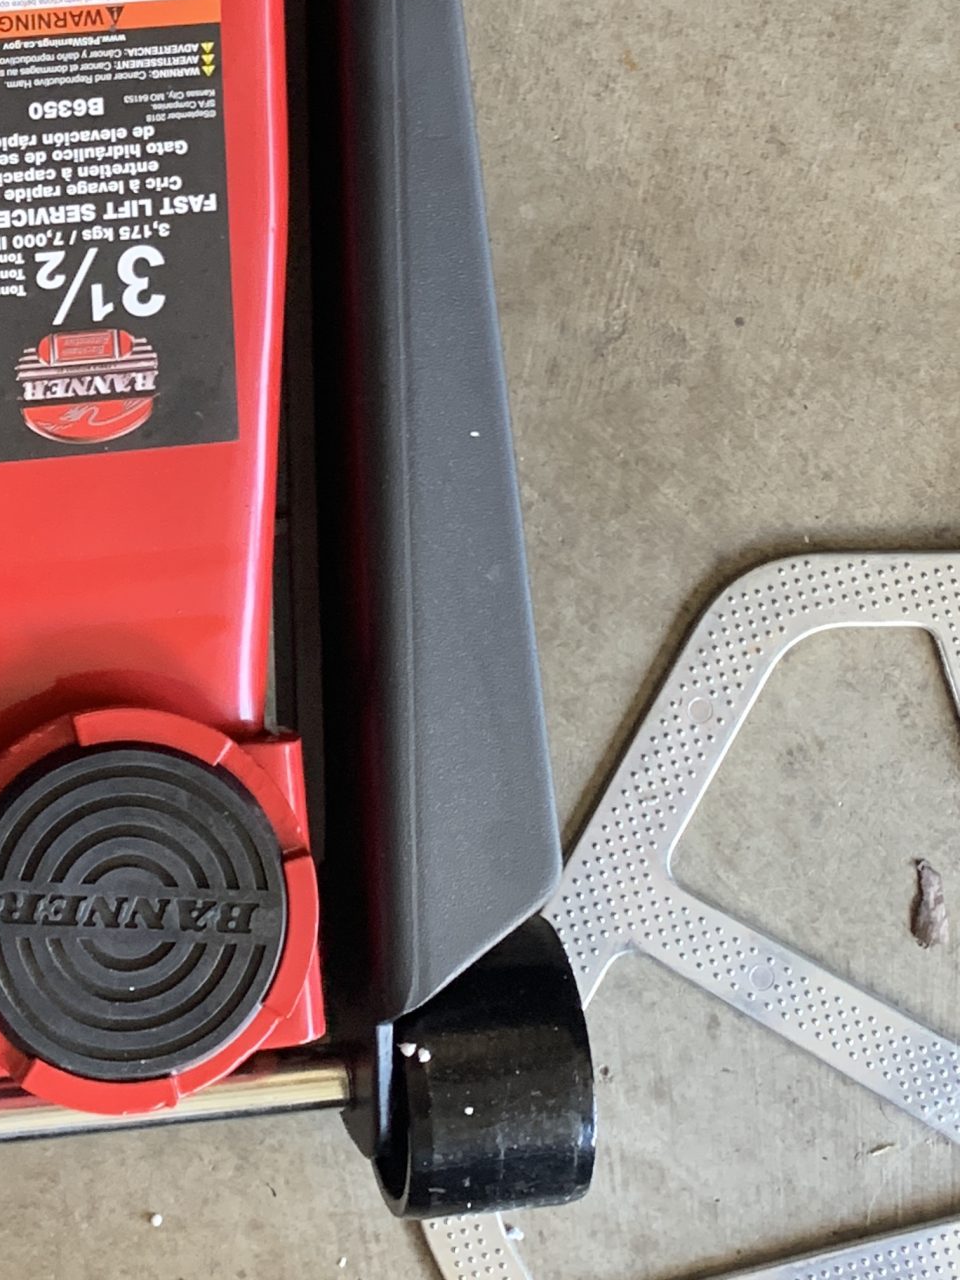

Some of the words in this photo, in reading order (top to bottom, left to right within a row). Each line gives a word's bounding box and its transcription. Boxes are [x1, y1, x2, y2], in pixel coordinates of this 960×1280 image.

[0, 31, 127, 52] www.P65Warnings.ca.gov
[122, 42, 199, 57] ADVERTENCIA:
[79, 48, 87, 58] y
[87, 47, 122, 60] Cáncer
[112, 53, 200, 70] AVERTISSEMENT:
[5, 67, 19, 76] au
[18, 62, 69, 76] dommages
[68, 63, 79, 72] et
[78, 60, 112, 73] Cancer
[147, 65, 200, 79] WARNING:
[2, 78, 32, 90] Harm.
[32, 73, 92, 88] Reproductive
[93, 72, 112, 83] and
[113, 69, 146, 82] Cancer
[26, 96, 105, 120] B6350
[196, 98, 216, 108] SFA
[41, 126, 127, 148] elevación
[131, 124, 154, 141] de
[50, 142, 141, 164] hidráulico
[144, 138, 188, 157] Gato
[23, 149, 47, 166] de
[60, 166, 73, 181] à
[76, 159, 159, 180] entretien
[65, 176, 124, 199] levage
[127, 177, 141, 194] à
[144, 174, 182, 192] Cric
[2, 181, 61, 204] rapide
[100, 197, 153, 219] LIFT
[157, 192, 218, 215] FAST
[68, 229, 77, 245] /
[81, 224, 113, 244] kgs
[118, 220, 170, 240] 3,175
[11, 229, 63, 249] 7,000
[22, 370, 158, 400] BANNER
